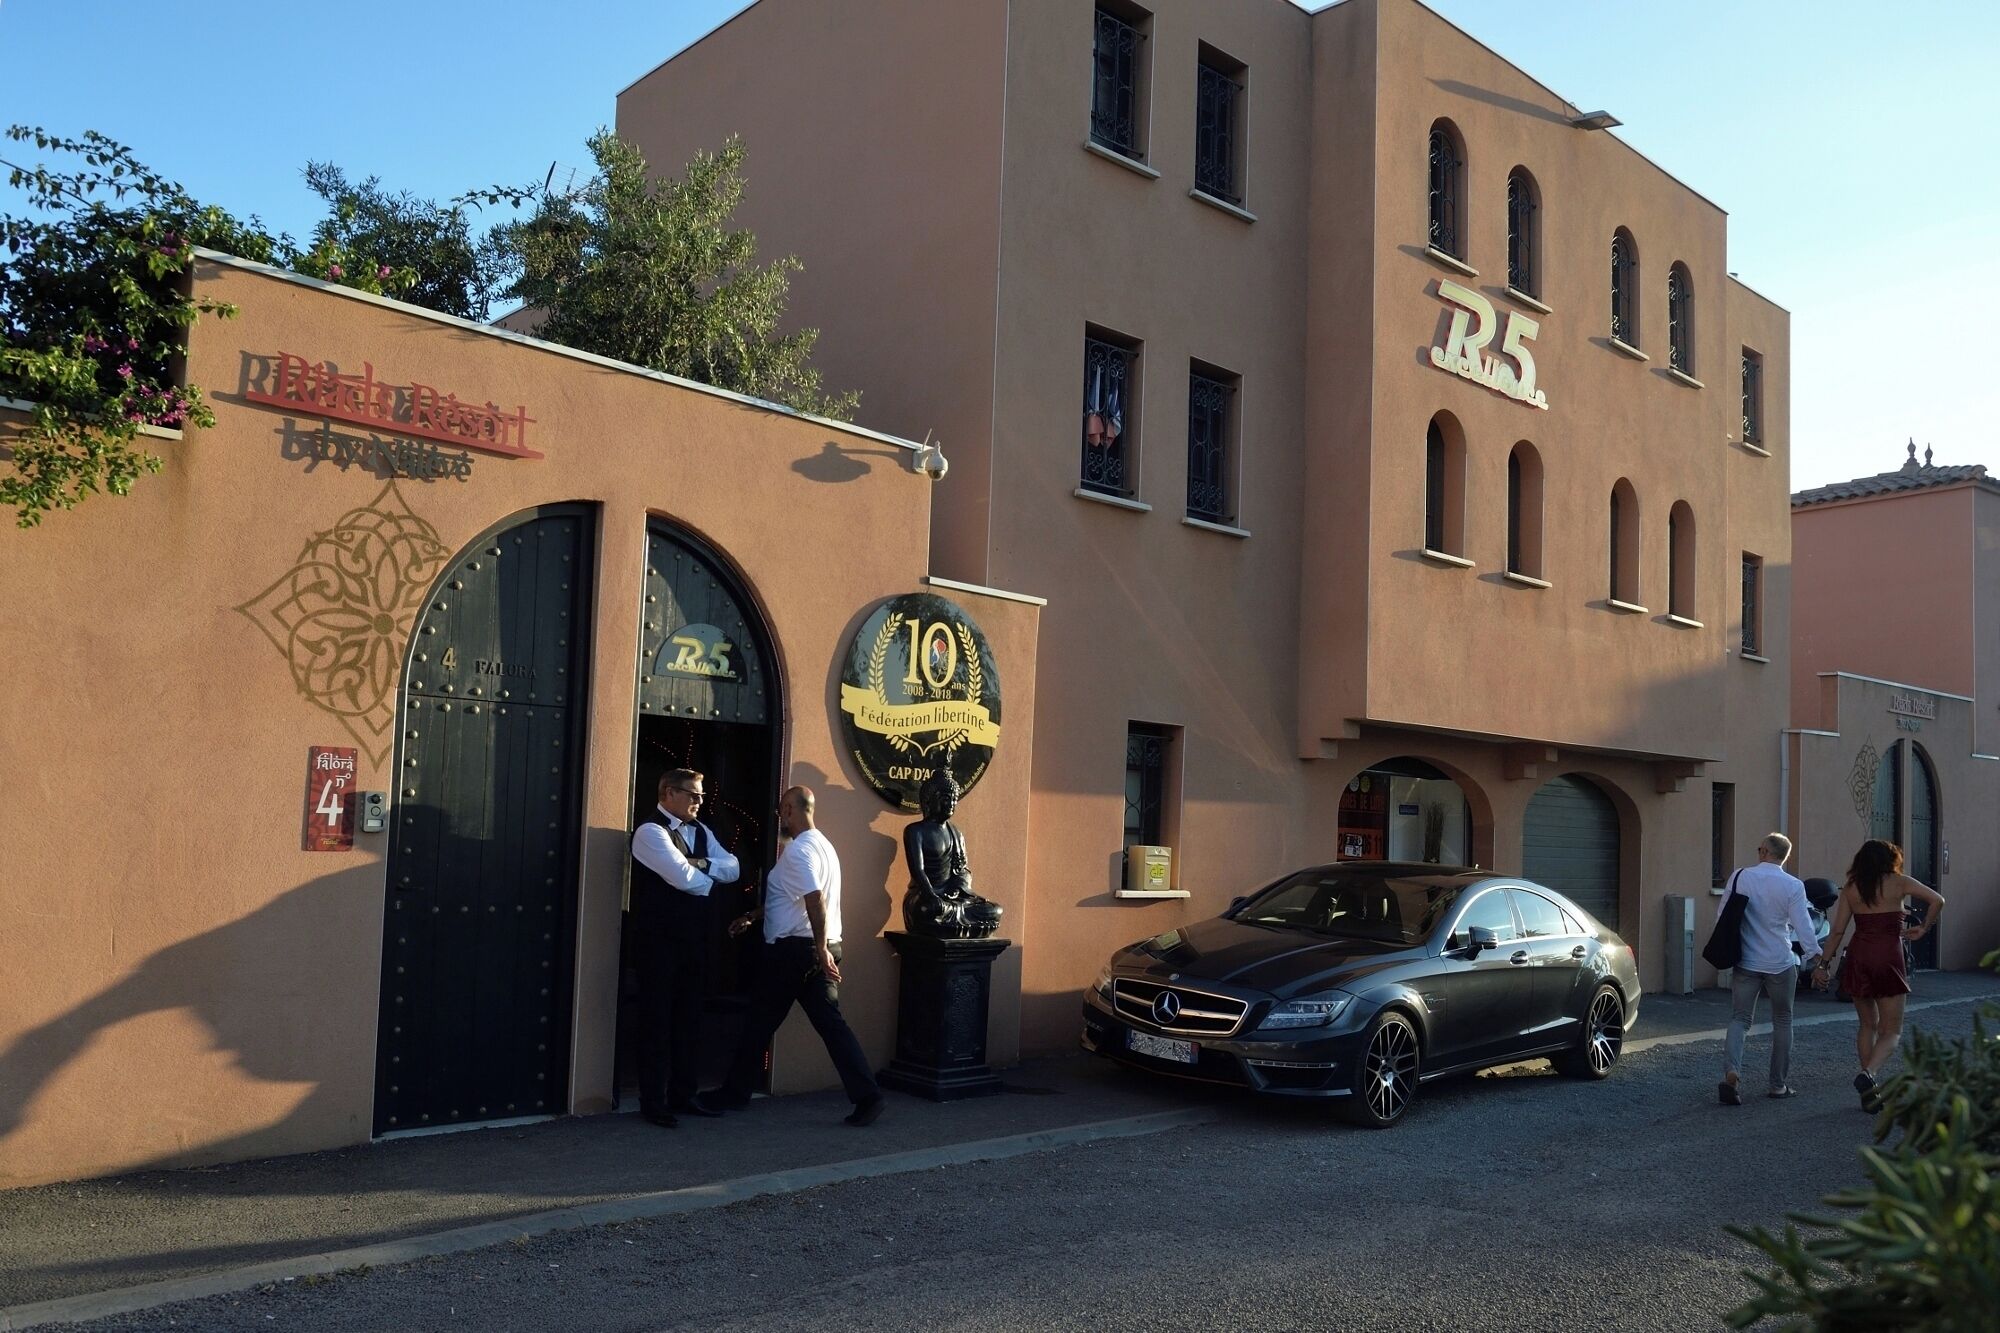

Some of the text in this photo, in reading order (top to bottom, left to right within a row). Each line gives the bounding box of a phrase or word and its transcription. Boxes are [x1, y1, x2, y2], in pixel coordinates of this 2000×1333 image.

[1438, 279, 1540, 396] R5
[277, 350, 538, 451] Riads Resort
[441, 647, 537, 680] 4 FALORA
[672, 636, 733, 673] R5
[902, 618, 966, 691] 10 ans
[902, 684, 924, 697] 2008
[930, 688, 951, 700] 2018
[861, 705, 986, 732] Fédération libertine
[854, 750, 875, 782] Association
[888, 766, 912, 780] CAP
[316, 779, 344, 826] 4
